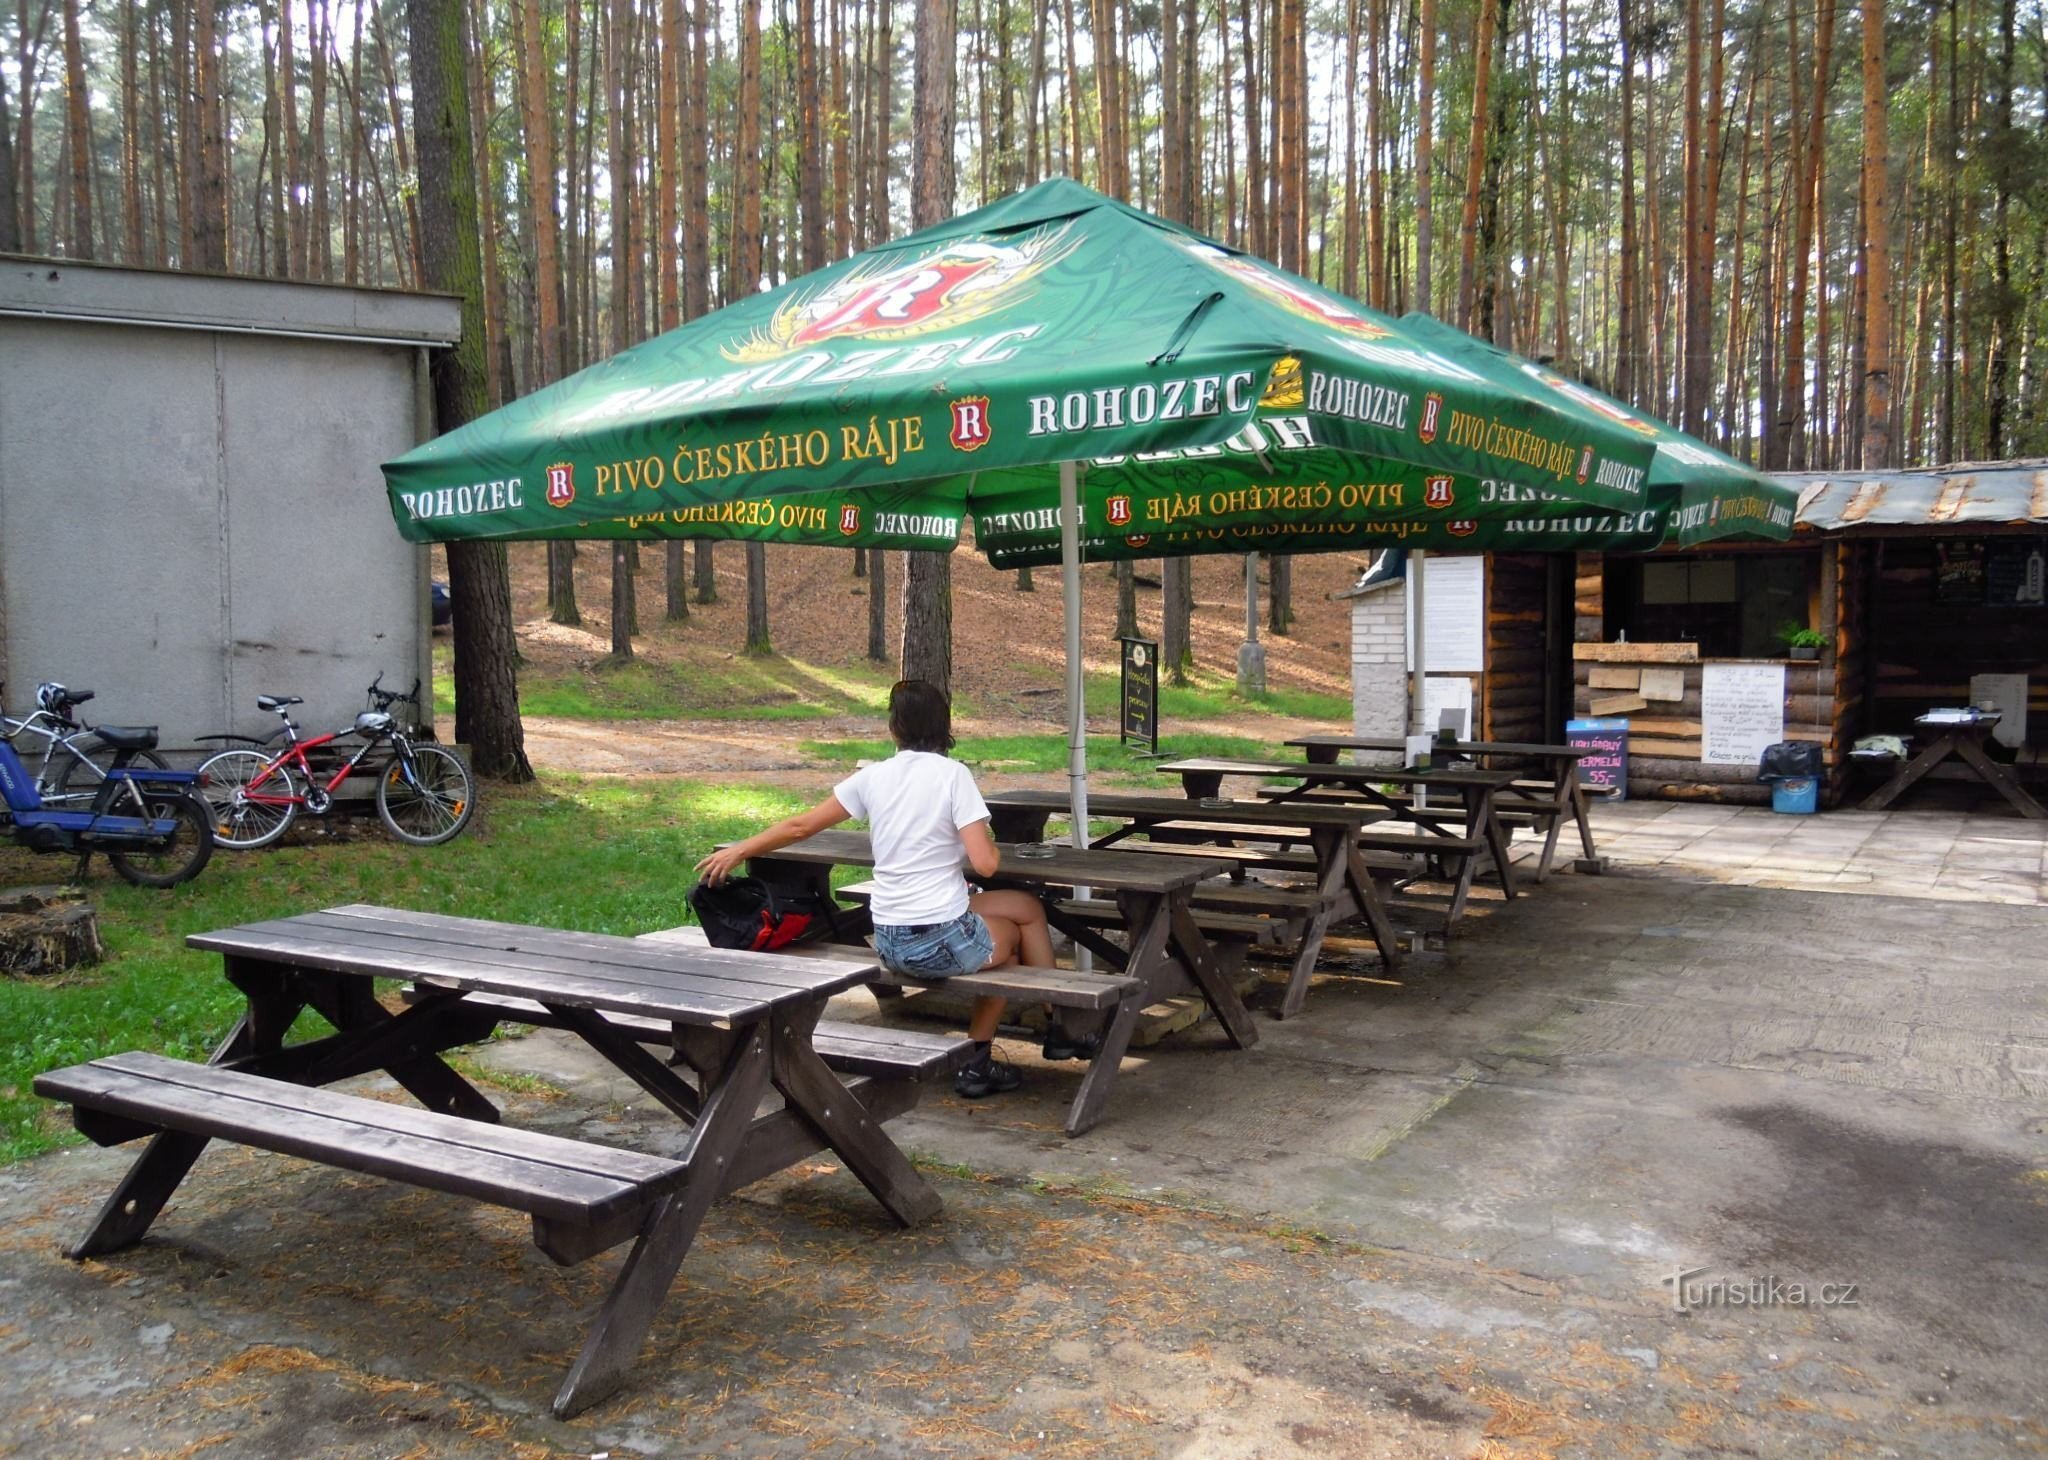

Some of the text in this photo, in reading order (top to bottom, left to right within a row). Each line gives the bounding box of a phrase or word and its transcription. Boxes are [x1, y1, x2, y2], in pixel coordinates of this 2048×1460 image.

[401, 372, 1253, 521] ROHOZEC R PIVO ČESKÉHO RÁJE R ROHOZEC
[1308, 373, 1409, 430] ROHOZEC
[1424, 398, 1439, 433] R
[1446, 411, 1485, 451] PIVO
[1485, 416, 1547, 468] ČESKÉHO
[1549, 439, 1576, 481] RÁJE
